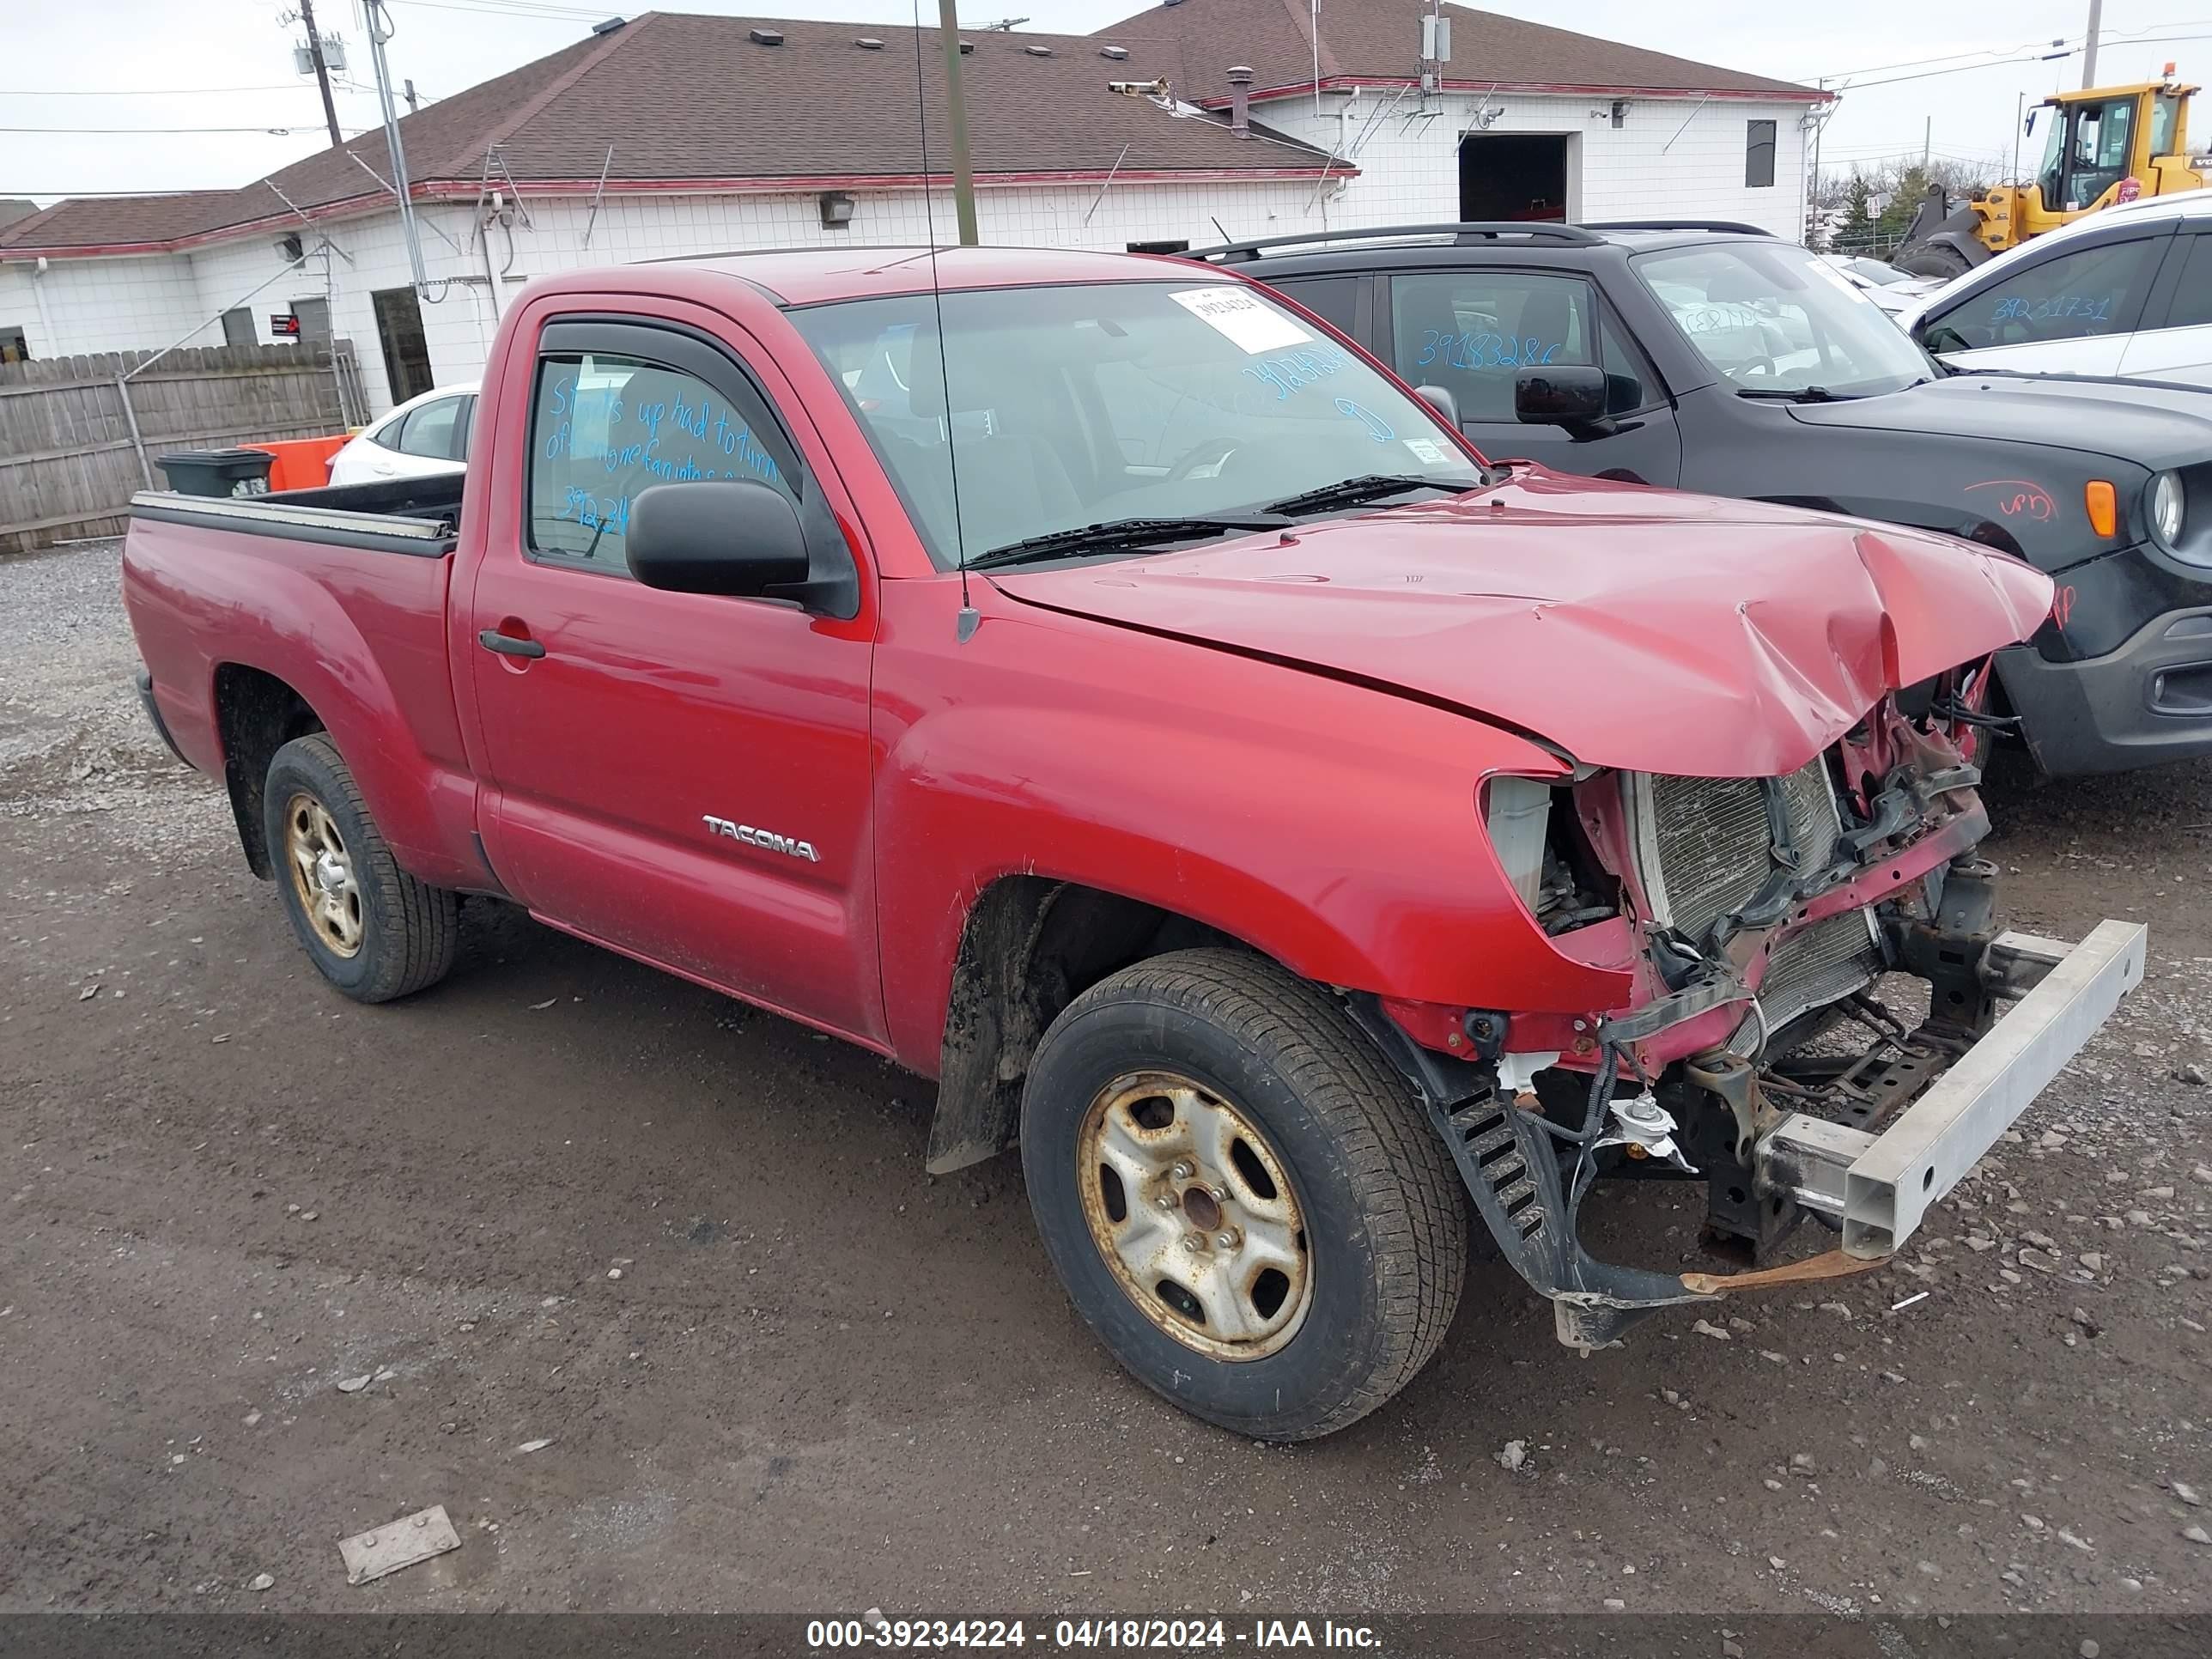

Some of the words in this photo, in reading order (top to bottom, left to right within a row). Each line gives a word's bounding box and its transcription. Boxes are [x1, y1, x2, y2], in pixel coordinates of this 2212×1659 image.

[1195, 298, 1258, 316] 39234224
[1991, 295, 2110, 322] 39231731
[1418, 330, 1561, 369] 39183286
[638, 402, 665, 438] up
[672, 391, 710, 443] had
[702, 814, 821, 863] TACOMA
